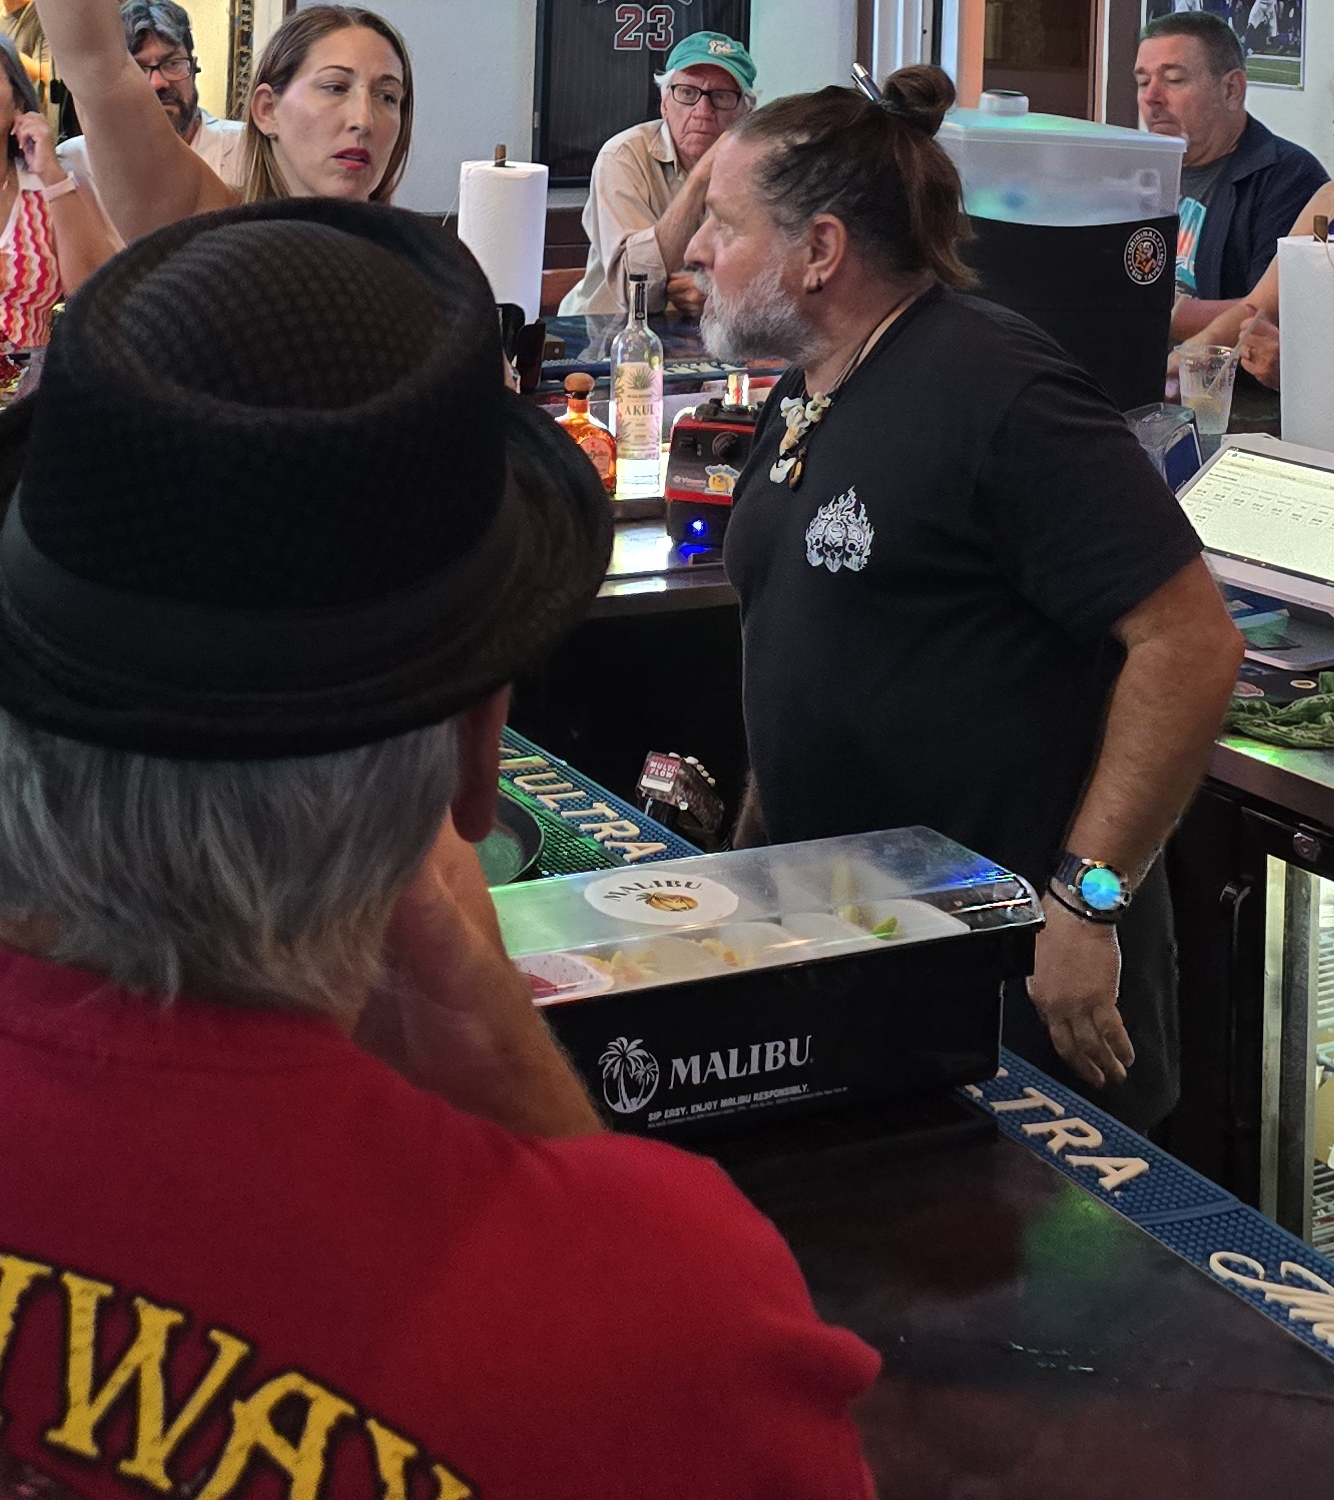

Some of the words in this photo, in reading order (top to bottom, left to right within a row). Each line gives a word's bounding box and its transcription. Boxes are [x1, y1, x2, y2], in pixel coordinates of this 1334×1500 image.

[614, 4, 675, 51] 23
[650, 769, 674, 780] FLOW
[514, 771, 668, 864] ULTRA
[603, 880, 703, 902] MALIBU
[668, 1035, 813, 1090] MALIBU
[648, 1110, 663, 1122] SIP
[690, 1099, 718, 1115] ENJOY
[720, 1094, 752, 1109] MALIBU
[958, 1067, 1150, 1193] TRA
